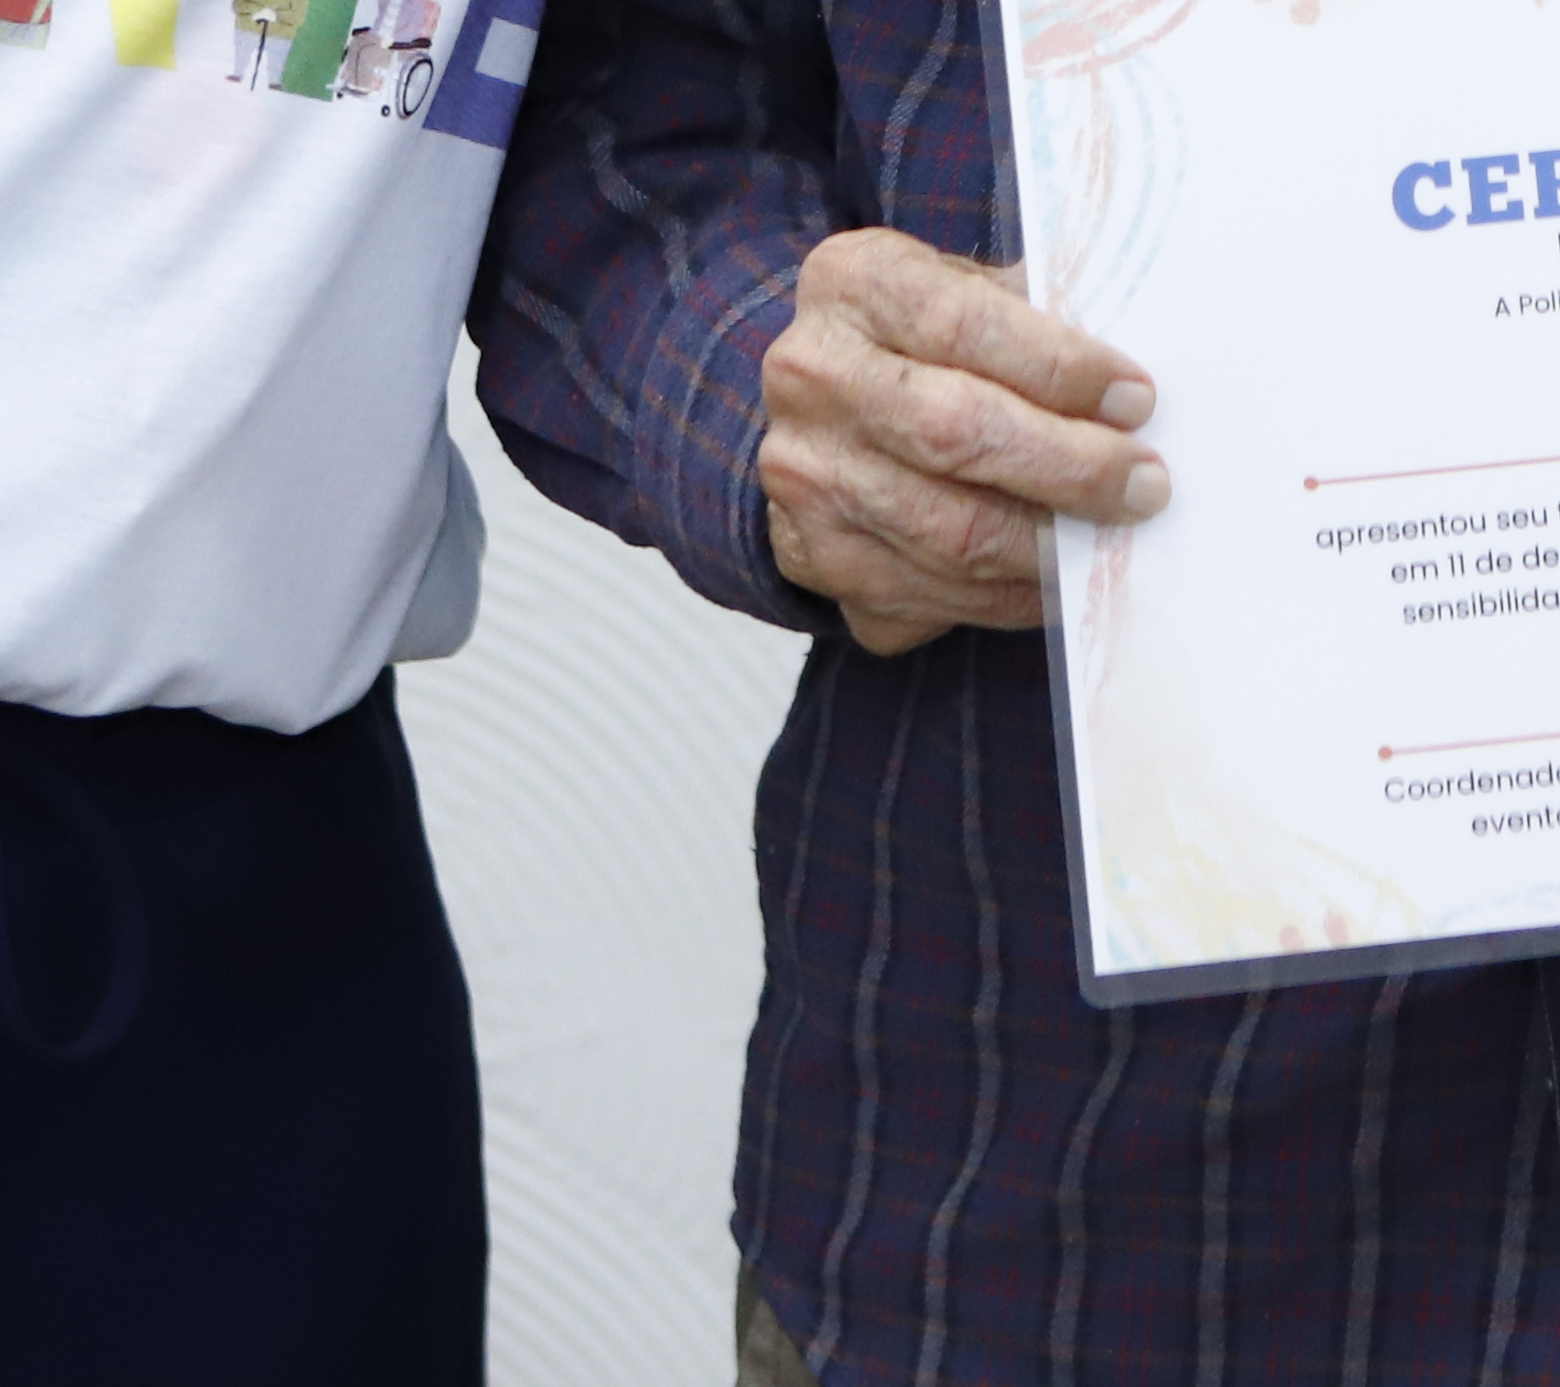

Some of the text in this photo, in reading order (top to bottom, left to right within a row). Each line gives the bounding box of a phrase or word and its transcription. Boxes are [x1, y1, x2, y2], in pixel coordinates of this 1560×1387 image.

[1494, 296, 1511, 318] A
[1315, 513, 1487, 555] apresentou
[1496, 507, 1548, 531] seu
[1390, 560, 1439, 584] em
[1447, 552, 1466, 578] 11
[1475, 548, 1513, 575] de
